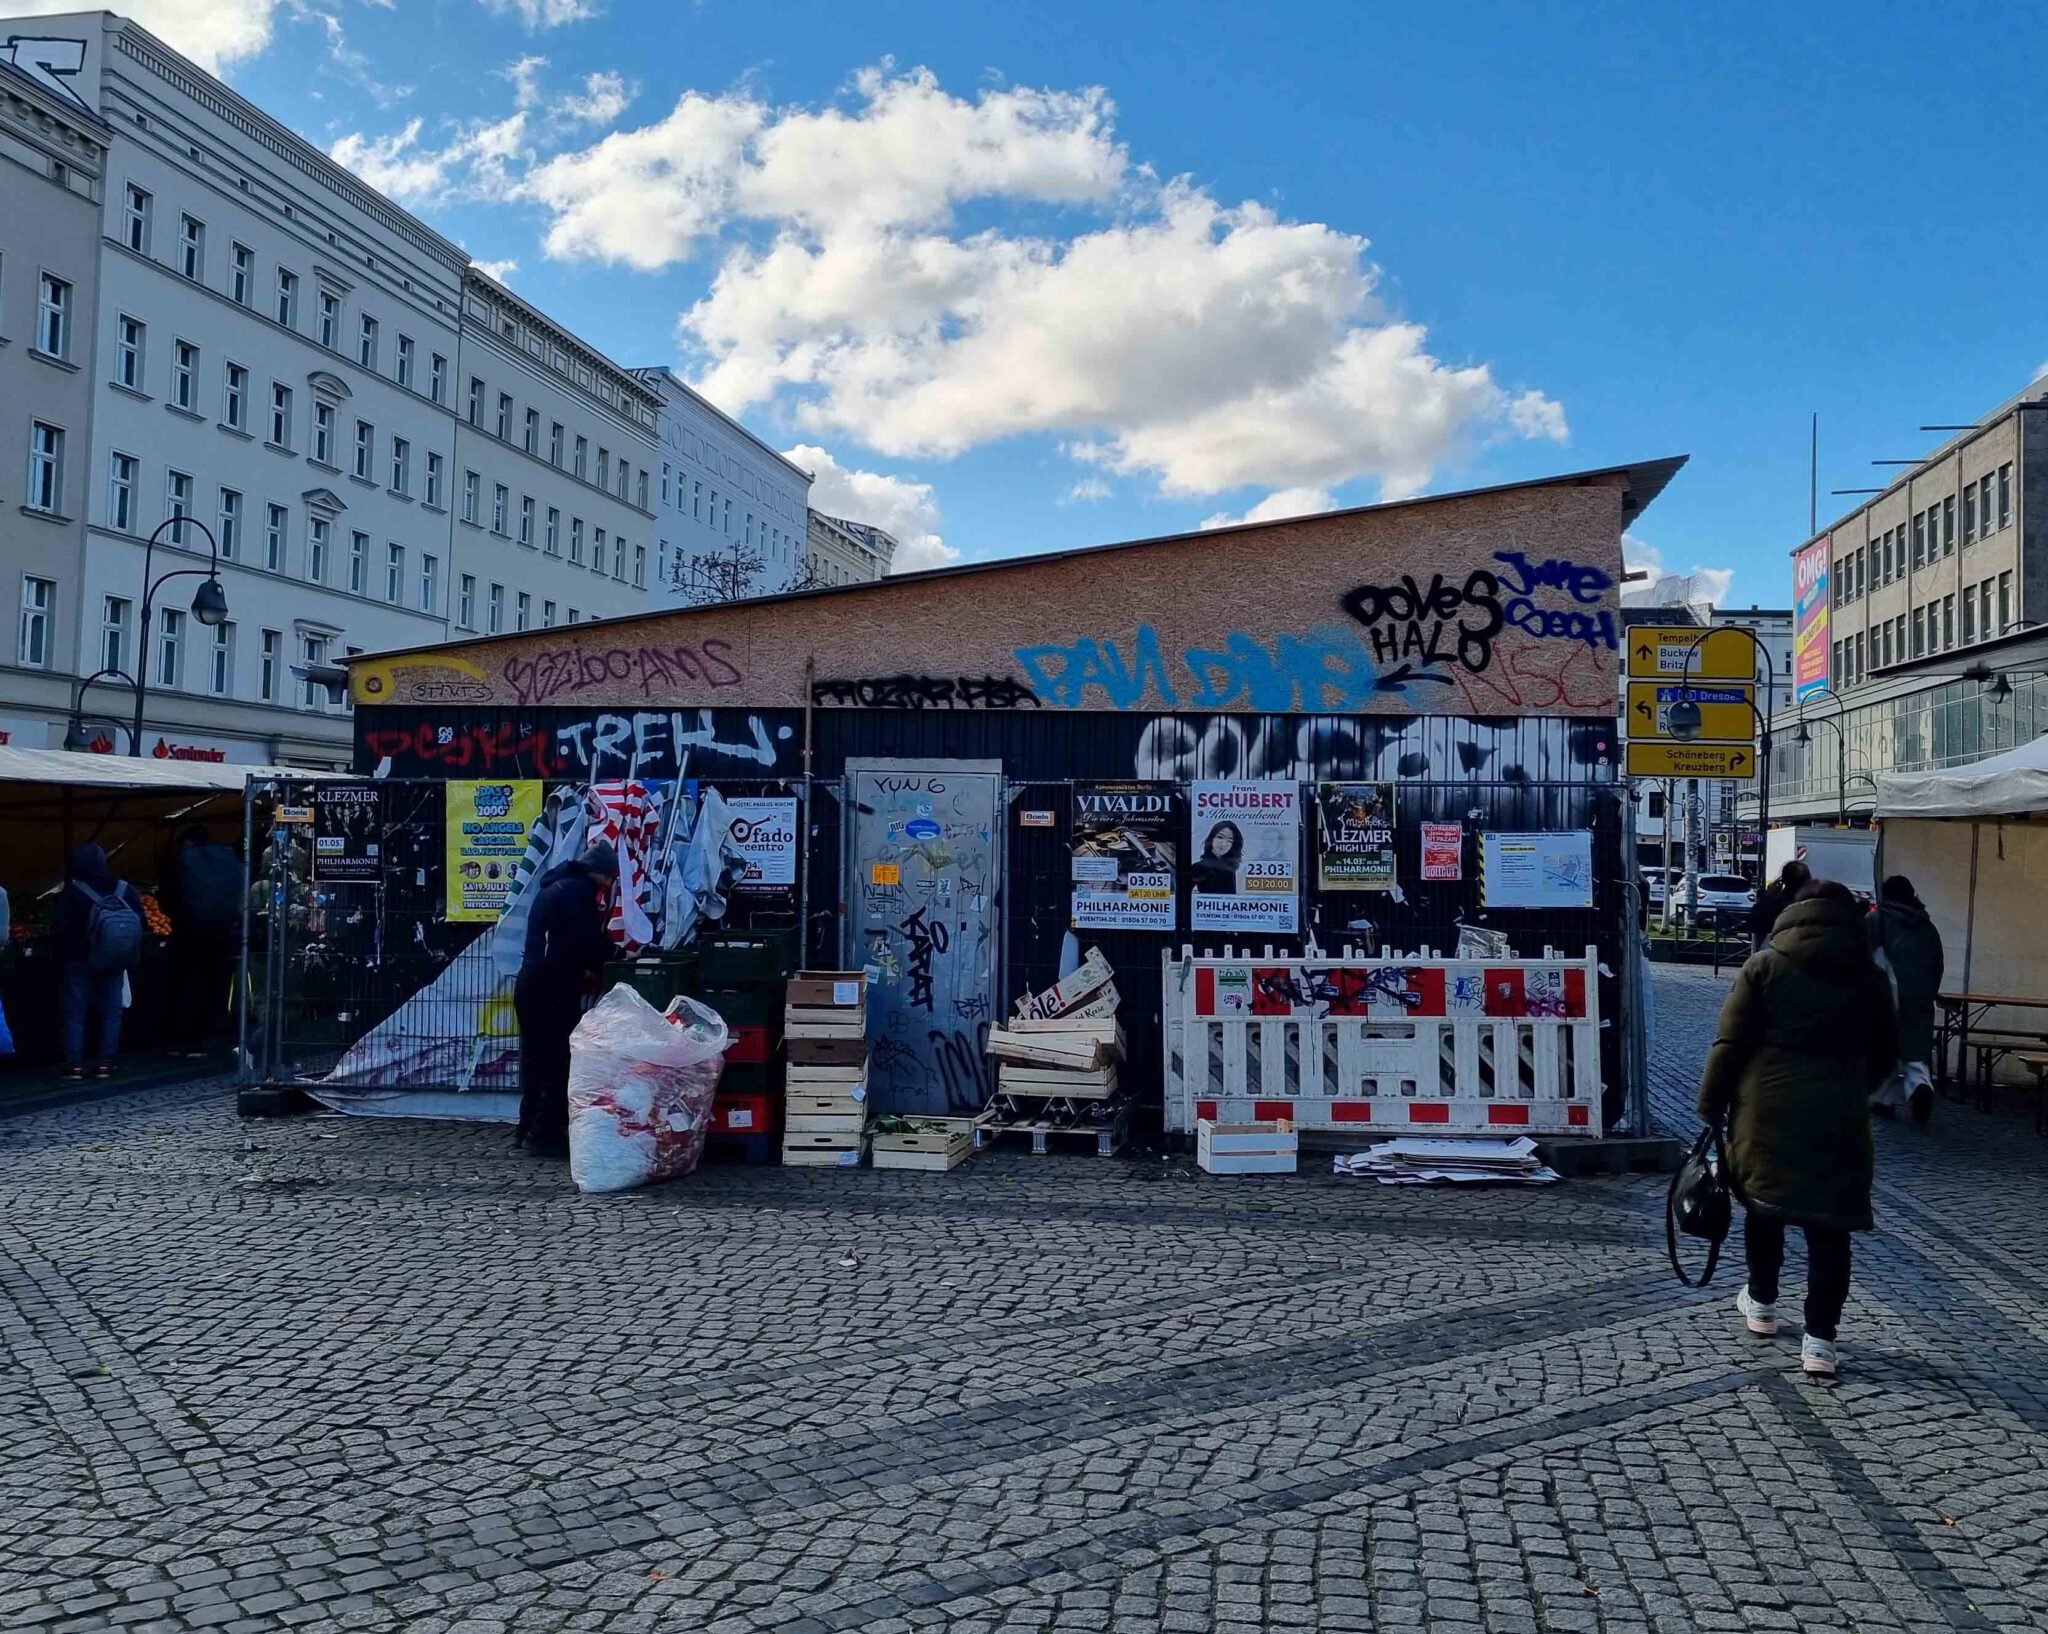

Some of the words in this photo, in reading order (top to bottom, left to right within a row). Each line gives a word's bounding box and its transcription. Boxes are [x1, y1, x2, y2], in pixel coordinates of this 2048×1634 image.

[1799, 546, 1826, 588] OMG!
[1660, 660, 1684, 669] Britz
[1700, 691, 1742, 701] Dresde
[168, 743, 226, 763] Santander
[1666, 750, 1726, 762] Schöneberg
[1674, 762, 1726, 773] Kreuzberg
[317, 791, 379, 802] KLEZMER
[479, 786, 502, 796] DAS
[475, 796, 507, 805] MEGA
[1076, 795, 1172, 812] VIVALDI
[1197, 793, 1294, 808] SCHUBERT
[283, 809, 308, 817] Boels
[1206, 808, 1285, 820] Klavierabend
[463, 822, 481, 833] NO
[482, 822, 524, 833] ANGELS
[753, 827, 793, 843] fado
[744, 843, 784, 852] centro
[1335, 844, 1359, 852] HIGH
[1360, 845, 1379, 853] LIFE
[1247, 864, 1289, 876] 23.03.
[486, 883, 504, 891] JULI
[1129, 876, 1167, 887] 03.05.
[1248, 879, 1260, 888] SO
[1266, 880, 1289, 888] 20.00
[1077, 901, 1170, 913] PHILHARMONIE
[1196, 901, 1289, 912] PHILHARMONIE
